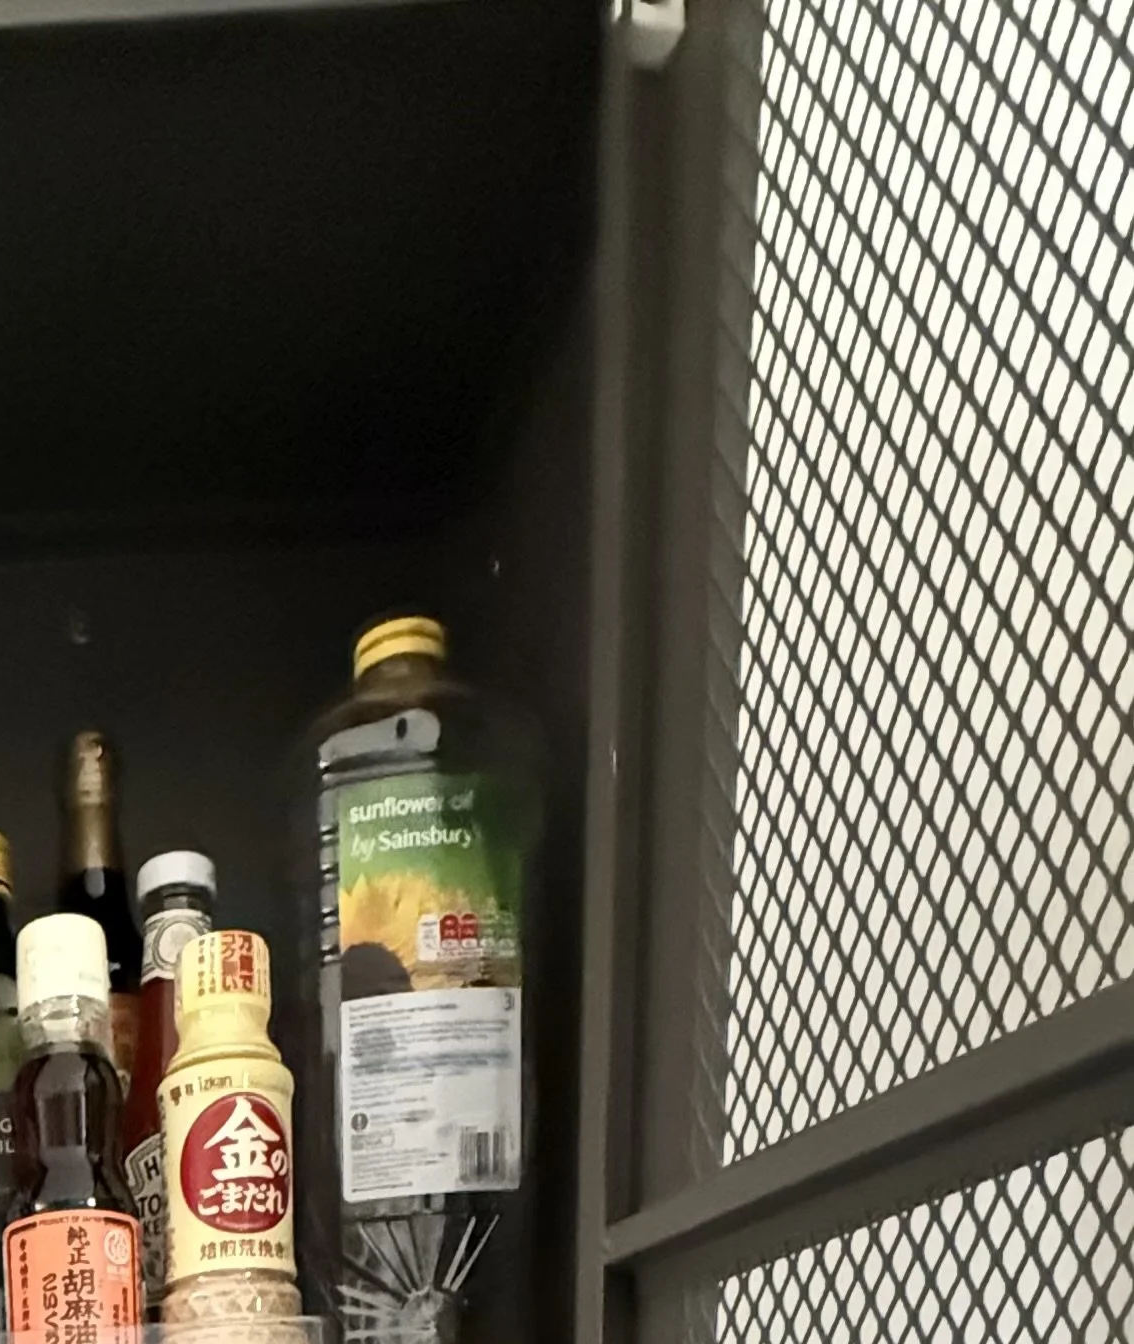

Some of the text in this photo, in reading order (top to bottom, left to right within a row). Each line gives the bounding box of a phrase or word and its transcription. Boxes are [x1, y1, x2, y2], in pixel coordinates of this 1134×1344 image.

[349, 795, 444, 824] sunflower
[350, 834, 375, 863] by
[203, 1096, 289, 1181] 金の
[197, 1181, 286, 1217] ごまだれ
